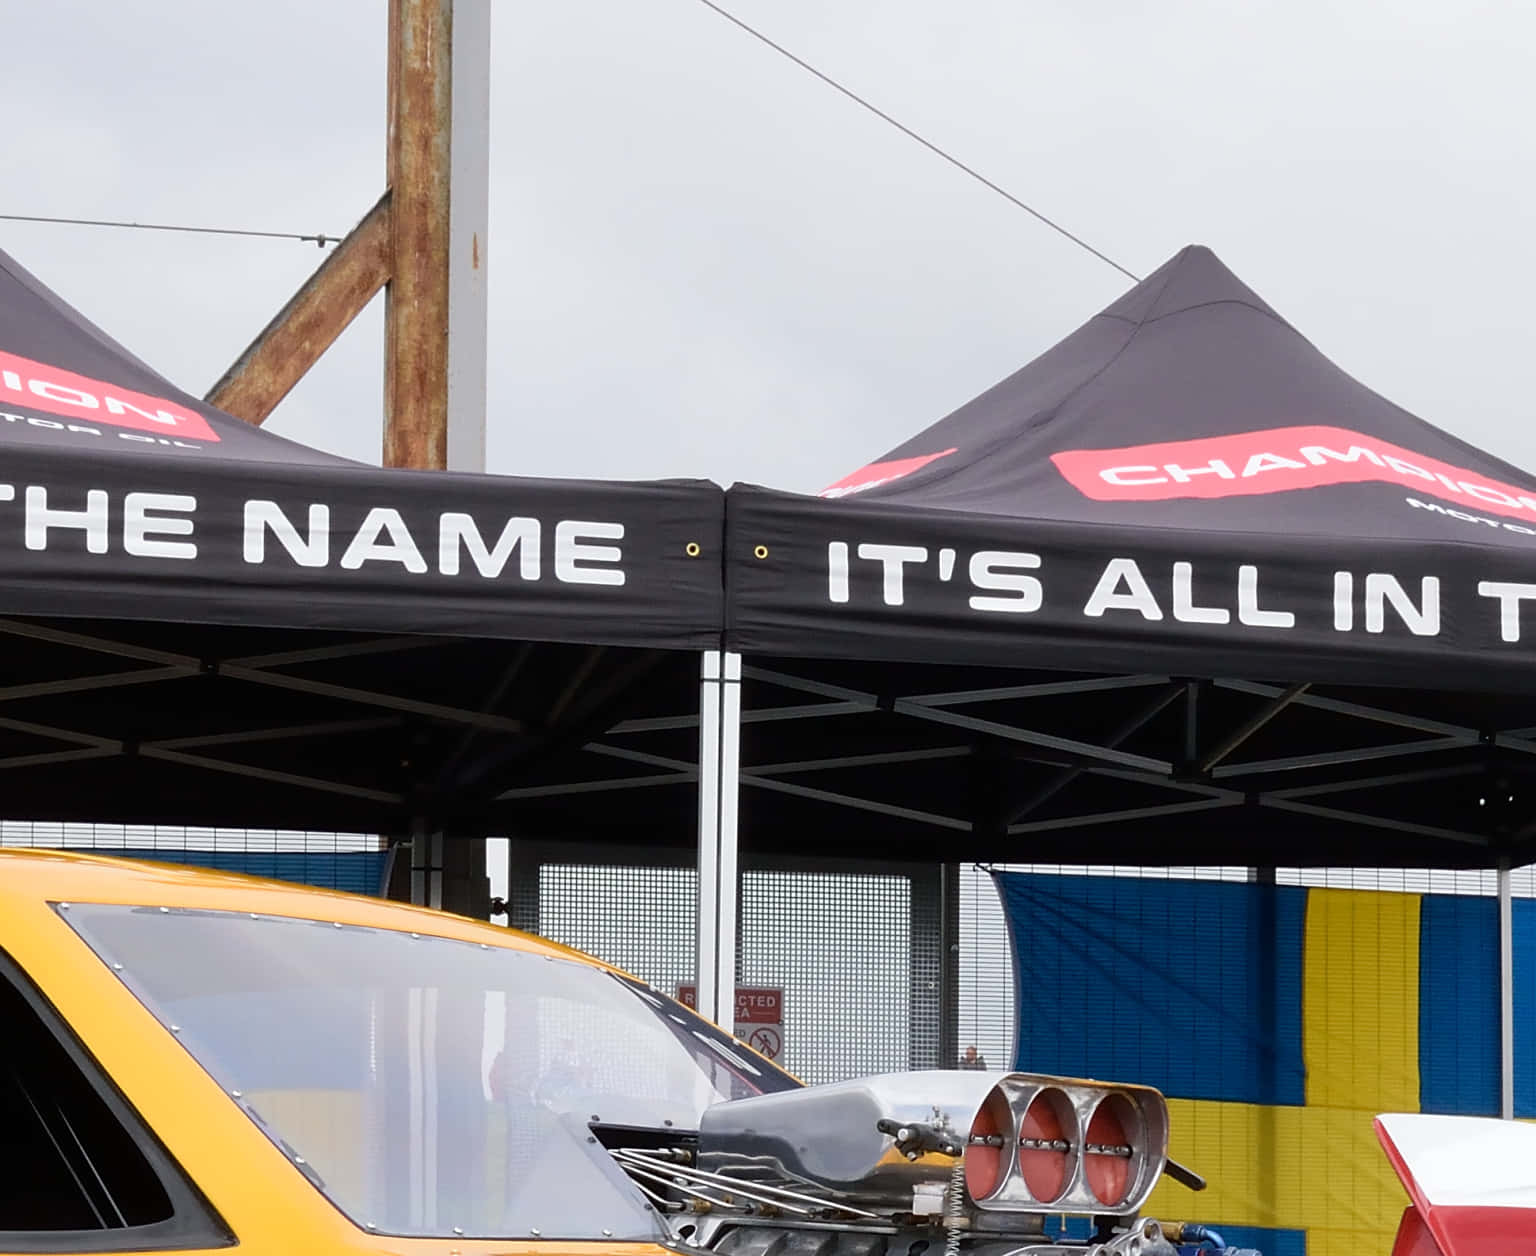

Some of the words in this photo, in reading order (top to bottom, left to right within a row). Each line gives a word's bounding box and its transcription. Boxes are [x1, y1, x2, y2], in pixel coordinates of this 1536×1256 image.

[119, 432, 203, 450] OIL
[243, 499, 626, 586] NAME
[828, 541, 1043, 613] IT'S
[1083, 558, 1295, 628] ALL
[1333, 571, 1441, 636] IN
